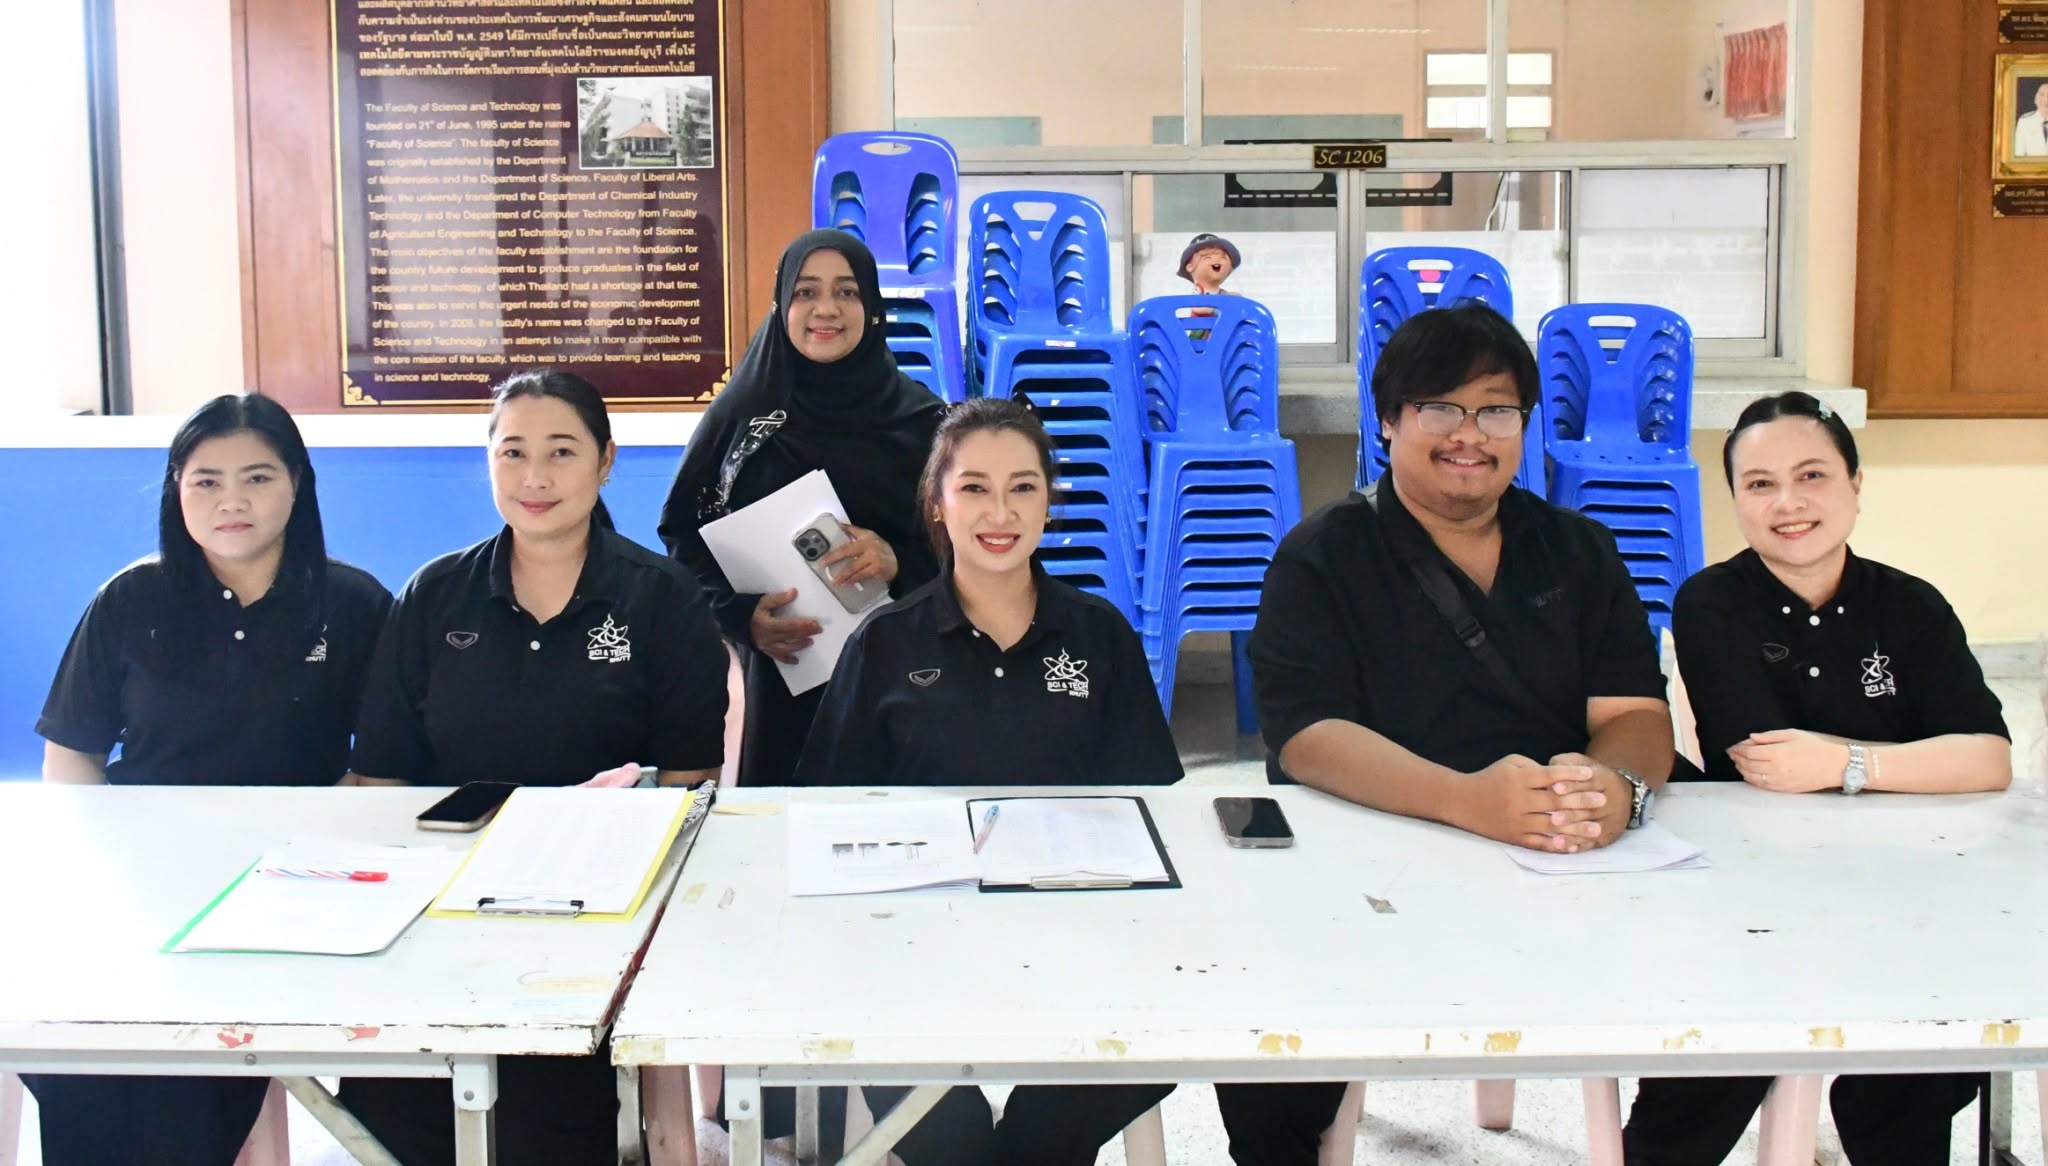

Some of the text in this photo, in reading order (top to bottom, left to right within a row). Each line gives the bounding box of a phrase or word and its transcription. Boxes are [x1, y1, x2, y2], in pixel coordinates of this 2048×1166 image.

[480, 32, 504, 41] 2549
[420, 103, 430, 112] of
[470, 102, 487, 111] and
[489, 101, 540, 113] Technology
[436, 121, 446, 130] of
[500, 120, 526, 129] under
[528, 120, 543, 129] the
[545, 121, 571, 129] name
[404, 139, 414, 148] of
[480, 138, 510, 149] faculty
[511, 138, 521, 147] of
[523, 137, 560, 147] Science
[496, 156, 511, 165] the
[513, 155, 566, 167] Department
[1316, 149, 1384, 165] SC 1206
[368, 175, 378, 184] of
[480, 174, 537, 185] Department
[538, 173, 548, 183] of
[593, 173, 628, 184] Faculty
[630, 172, 640, 182] of
[643, 172, 674, 181] Liberal
[676, 172, 698, 181] Arts.
[520, 192, 536, 201] the
[538, 191, 596, 202] Department
[598, 191, 608, 200] of
[610, 191, 656, 200] Chemical
[659, 190, 698, 202] Industry
[521, 210, 531, 219] of
[533, 209, 579, 221] Computer
[582, 209, 636, 220] Technology
[638, 209, 660, 218] from
[663, 208, 697, 220] Faculty
[369, 229, 380, 238] of
[498, 228, 516, 237] and
[518, 228, 573, 239] Technology
[576, 227, 585, 237] to
[588, 227, 603, 236] the
[606, 227, 641, 238] Faculty
[643, 227, 653, 236] of
[655, 226, 697, 236] Science.
[370, 247, 389, 256] The
[466, 246, 476, 255] of
[496, 246, 527, 257] faculty
[529, 245, 595, 255] establishment
[615, 245, 631, 254] the
[633, 244, 683, 254] foundation
[685, 244, 698, 253] for
[370, 265, 386, 274] the
[526, 264, 537, 273] to
[539, 263, 580, 274] produce
[582, 263, 632, 274] graduates
[635, 263, 645, 272] in
[646, 262, 663, 272] the
[665, 262, 686, 271] field
[688, 262, 699, 271] of
[486, 282, 496, 291] of
[498, 281, 526, 291] which
[527, 281, 569, 290] Thailand
[571, 281, 590, 290] had
[601, 280, 642, 292] shortage
[645, 280, 654, 290] at
[656, 280, 674, 289] that
[677, 280, 700, 289] time.
[372, 301, 393, 310] This
[529, 299, 559, 308] needs
[561, 299, 571, 308] of
[572, 299, 588, 308] the
[590, 298, 637, 308] economic
[639, 298, 700, 309] development
[372, 319, 382, 329] of
[383, 319, 399, 328] the
[584, 317, 624, 328] changed
[626, 317, 635, 326] to
[638, 317, 653, 326] the
[655, 316, 688, 328] Faculty
[690, 316, 700, 325] of
[373, 337, 411, 346] Science
[414, 336, 432, 346] and
[515, 335, 551, 346] attempt
[553, 335, 563, 344] to
[565, 335, 591, 344] make
[594, 335, 600, 344] it
[628, 334, 680, 345] compatible
[682, 334, 701, 343] with
[373, 355, 388, 364] the
[412, 354, 447, 364] mission
[448, 354, 458, 363] of
[460, 354, 474, 363] the
[476, 354, 507, 365] faculty,
[510, 353, 536, 362] which
[558, 353, 567, 362] to
[569, 353, 602, 364] provide
[605, 352, 640, 364] learning
[643, 352, 660, 362] and
[662, 352, 700, 363] teaching
[374, 372, 491, 383] in science and technology.
